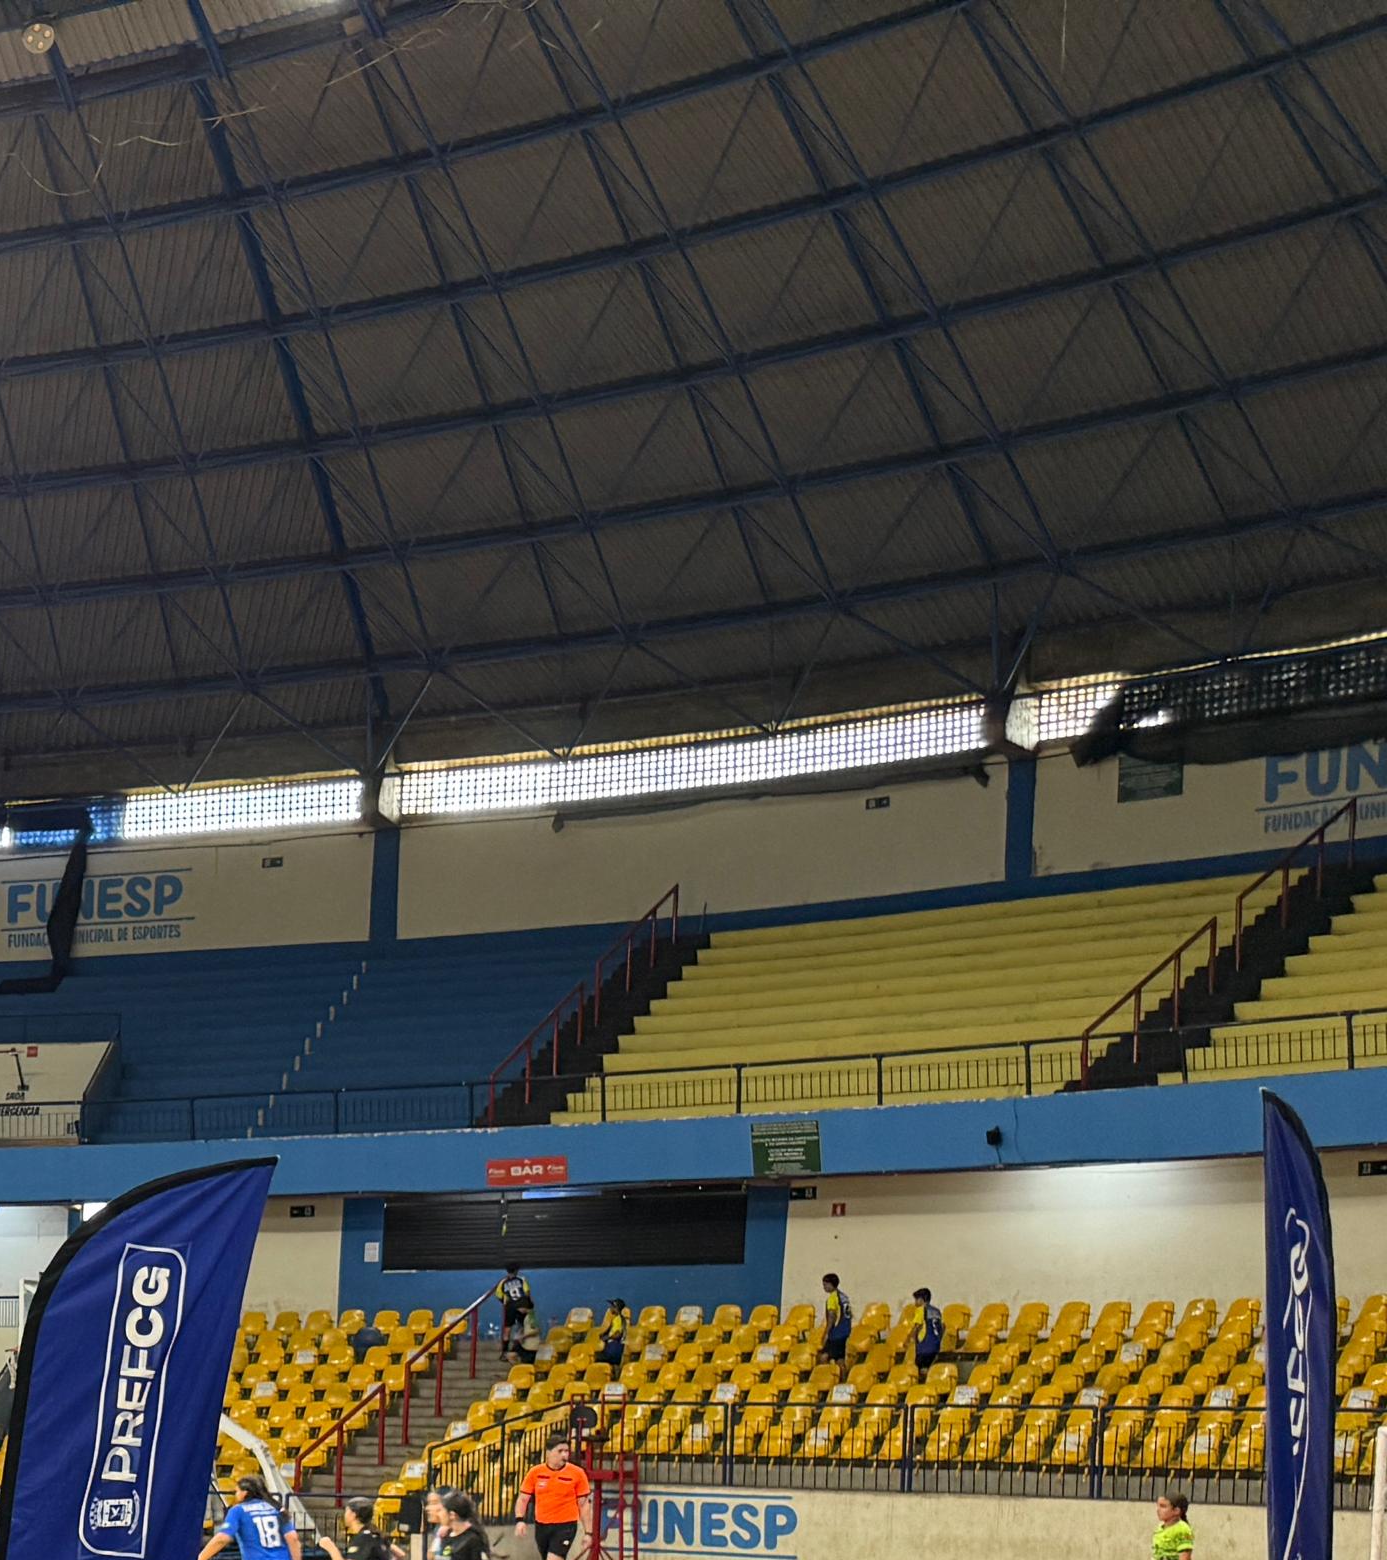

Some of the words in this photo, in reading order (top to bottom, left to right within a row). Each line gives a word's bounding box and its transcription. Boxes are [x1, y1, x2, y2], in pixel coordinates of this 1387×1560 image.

[117, 928, 128, 942] DE
[132, 924, 181, 941] ESPORTES
[510, 1164, 543, 1176] BAR
[100, 1265, 171, 1483] PREFCG
[252, 1516, 280, 1548] 18
